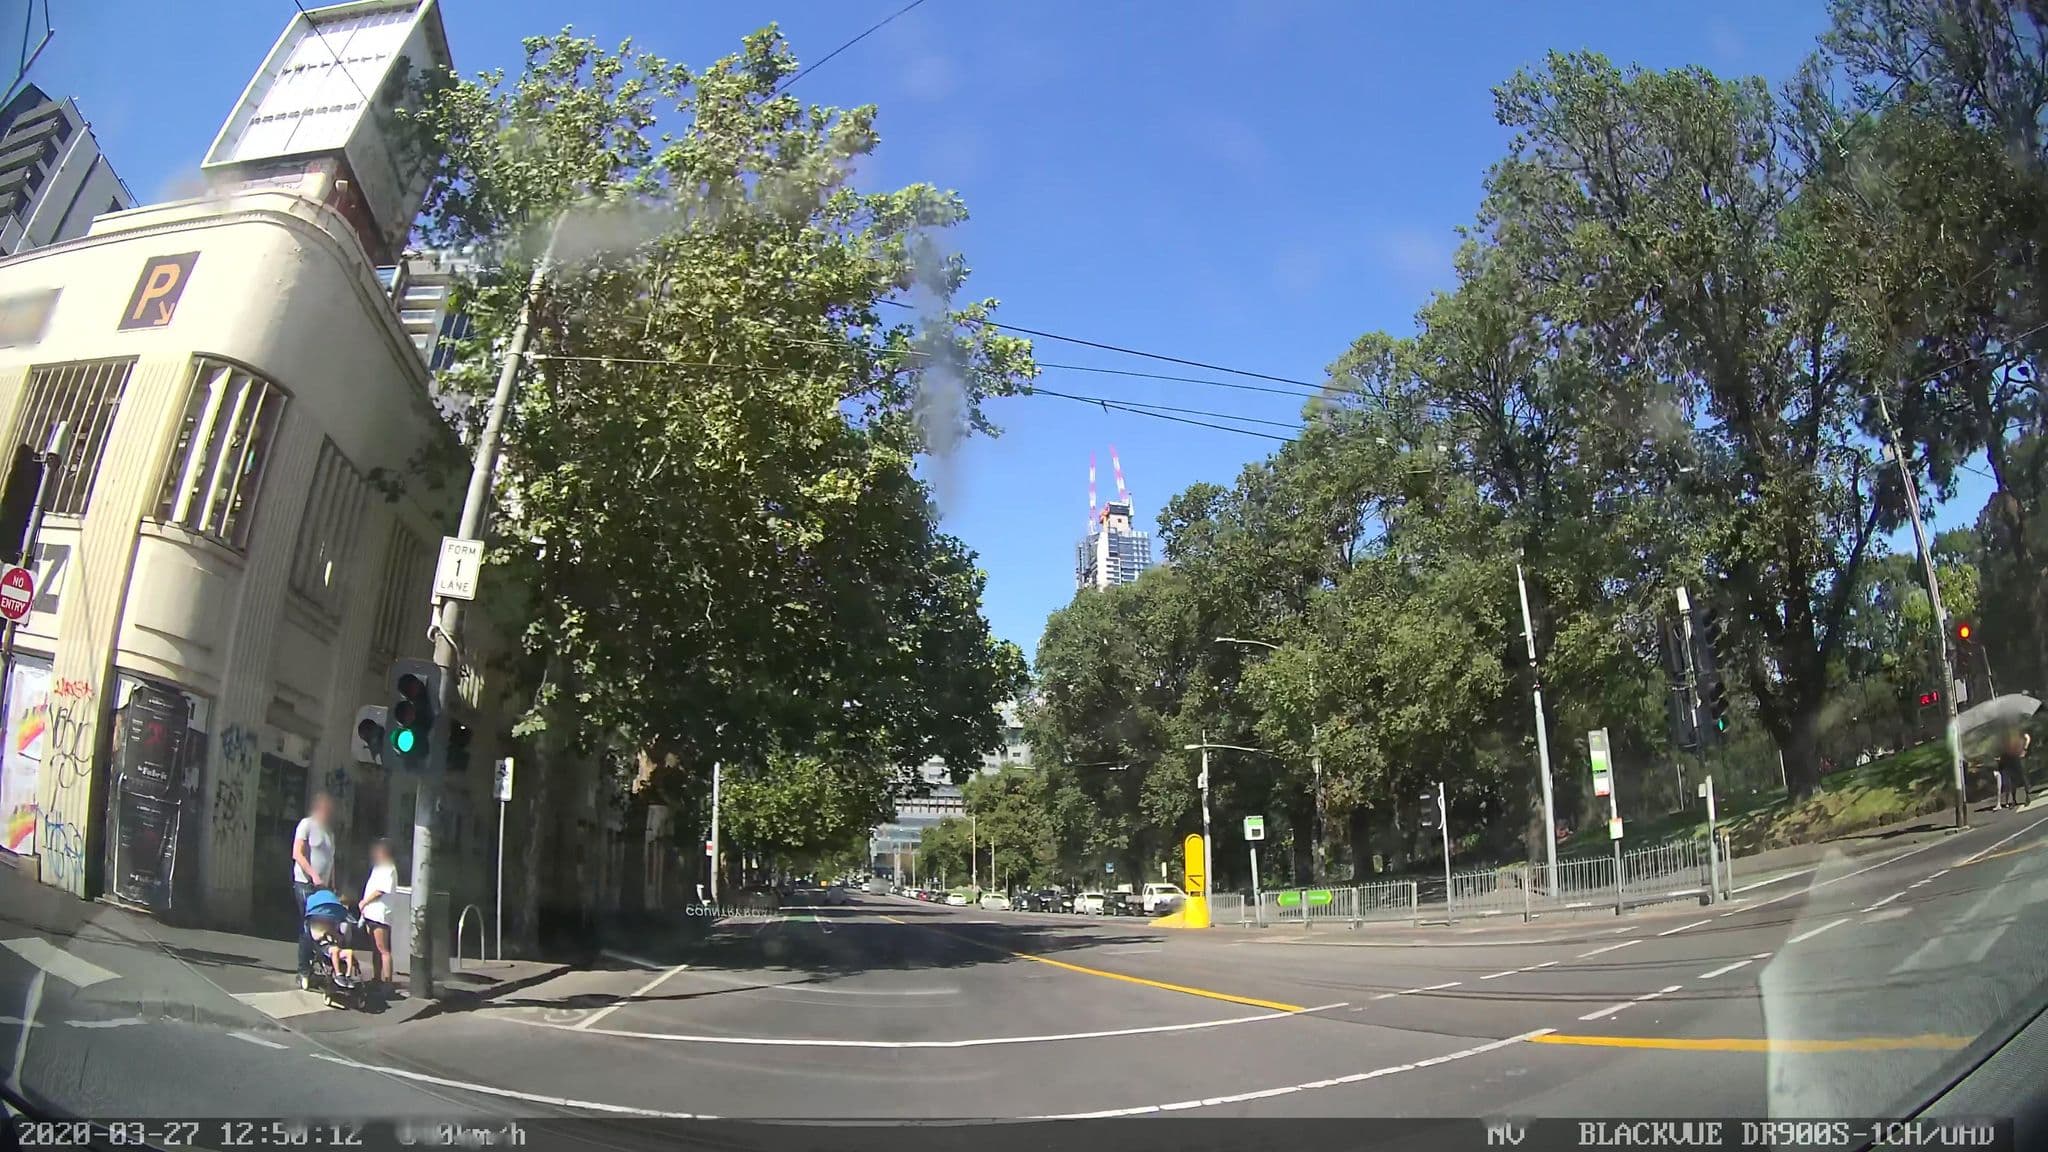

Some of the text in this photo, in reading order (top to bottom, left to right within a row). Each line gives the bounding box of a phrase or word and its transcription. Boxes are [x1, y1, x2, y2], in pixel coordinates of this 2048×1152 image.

[132, 263, 181, 320] P
[448, 544, 476, 556] FORM
[456, 558, 462, 577] 1
[12, 576, 24, 588] NO
[441, 580, 469, 592] LANE
[1, 597, 26, 613] ENTRY
